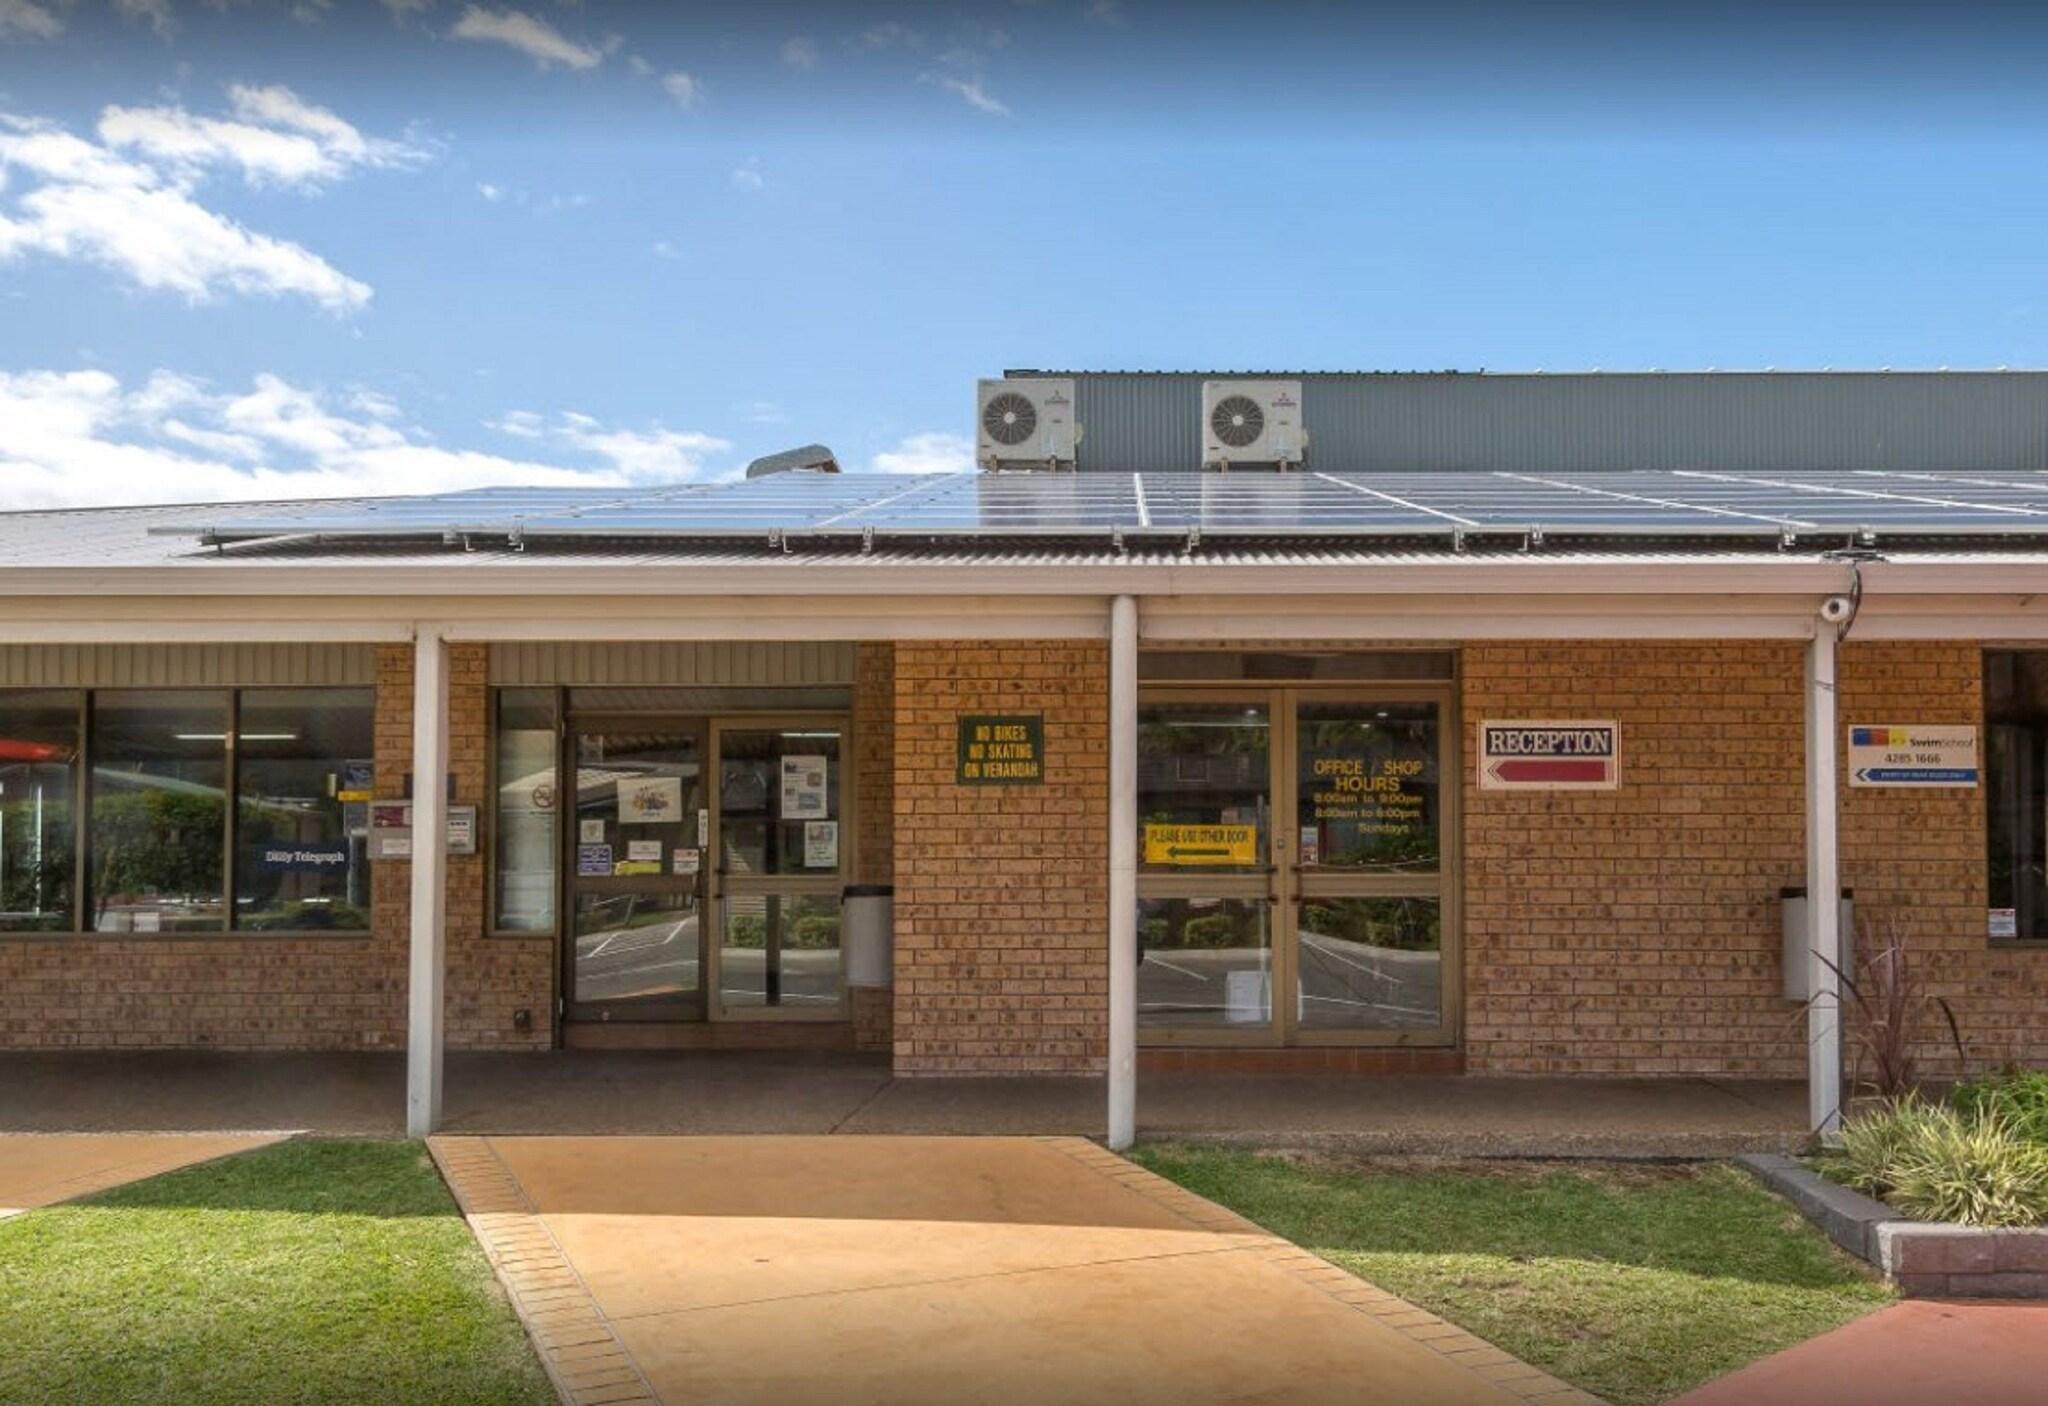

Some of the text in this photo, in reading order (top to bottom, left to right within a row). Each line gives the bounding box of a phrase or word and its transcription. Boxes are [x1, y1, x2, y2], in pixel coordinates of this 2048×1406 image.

[976, 725, 1027, 741] NO BIKES
[1489, 730, 1609, 753] RECEPTION
[969, 743, 1033, 759] NO SKATING
[1884, 753, 1941, 763] 4285 1666
[964, 762, 1039, 778] ON VERANDAH
[1314, 759, 1363, 775] OFFICE
[1383, 759, 1423, 775] SHOP
[1335, 776, 1401, 791] HOURS
[1363, 793, 1375, 804] to
[1361, 808, 1374, 818] to
[1150, 829, 1249, 844] PLEASE USE OTHER DOOR
[294, 851, 344, 865] Telegraph
